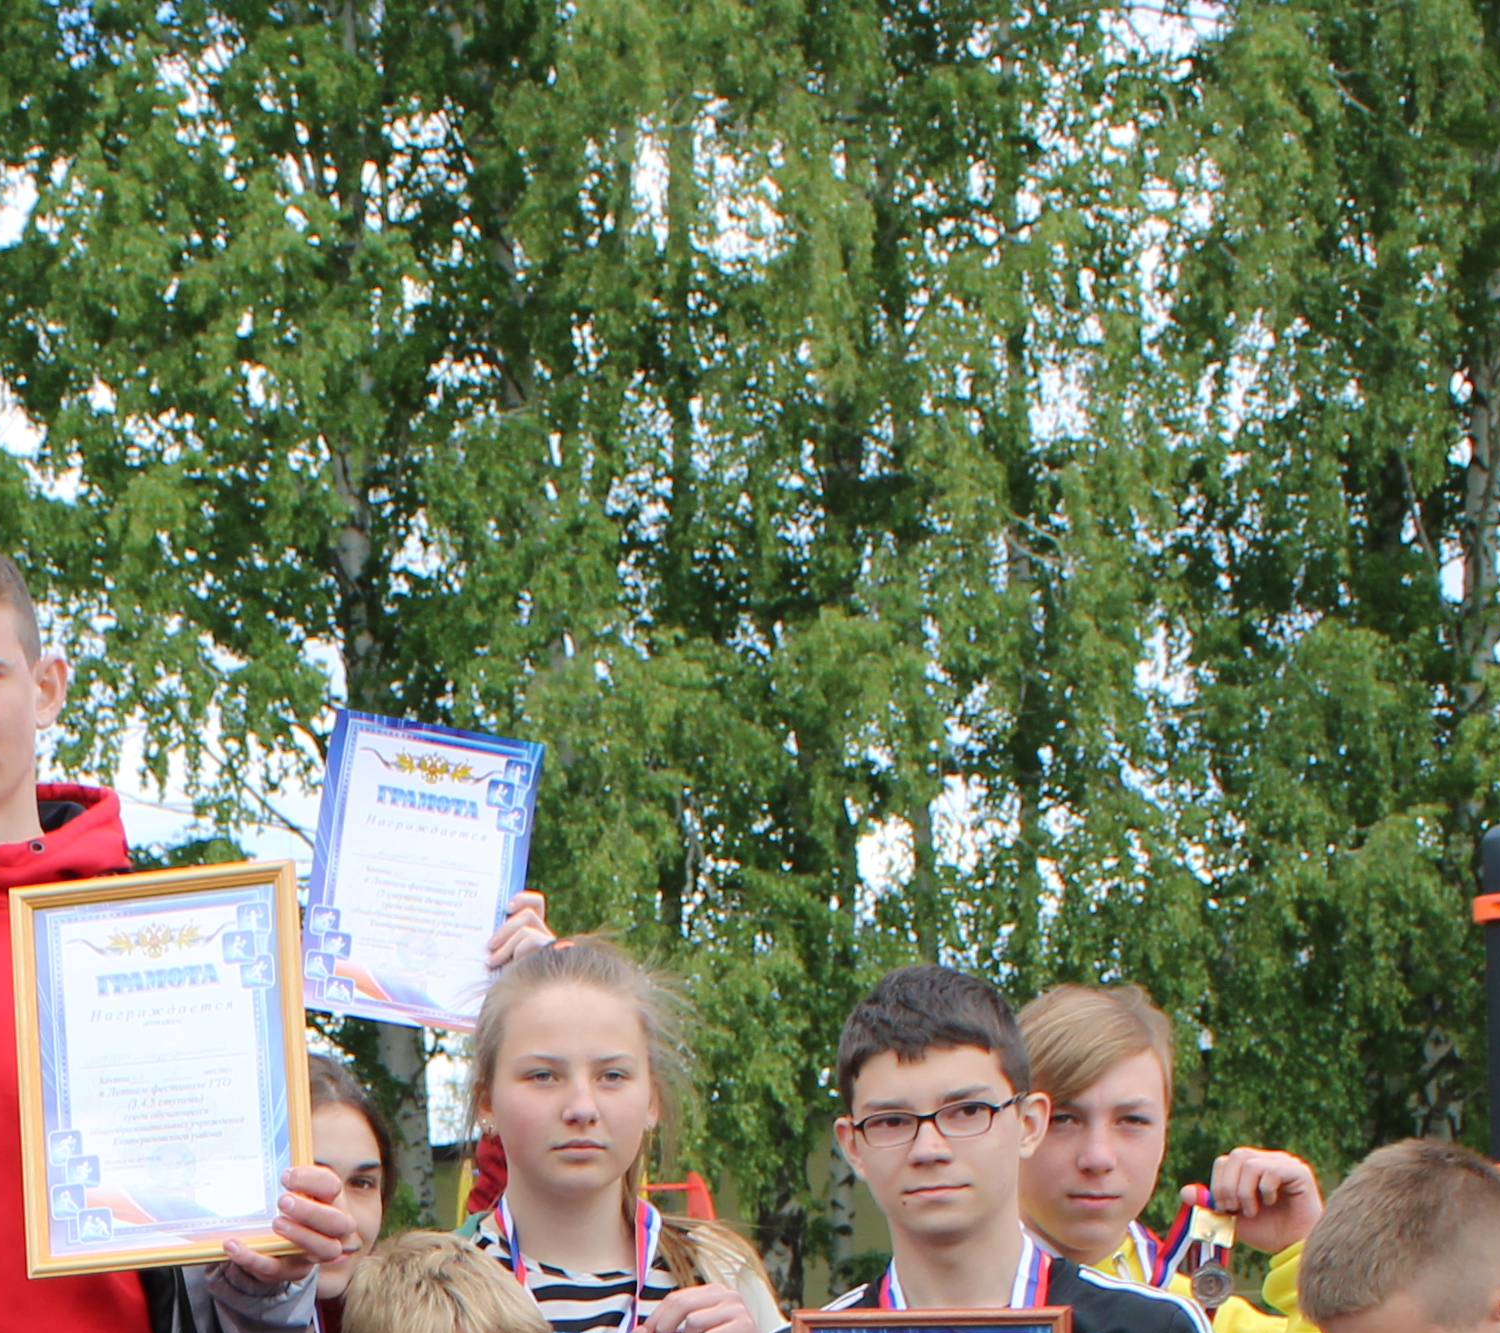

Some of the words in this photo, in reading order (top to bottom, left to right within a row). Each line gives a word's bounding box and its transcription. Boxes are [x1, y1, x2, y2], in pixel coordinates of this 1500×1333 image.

[376, 784, 479, 821] ГРАМОТА
[365, 813, 489, 844] Награждается
[96, 963, 220, 997] ГРАМОТА
[90, 1001, 234, 1024] Награждается
[107, 1087, 148, 1098] Летнем
[151, 1082, 206, 1095] фестивале
[209, 1078, 231, 1088] ГТО
